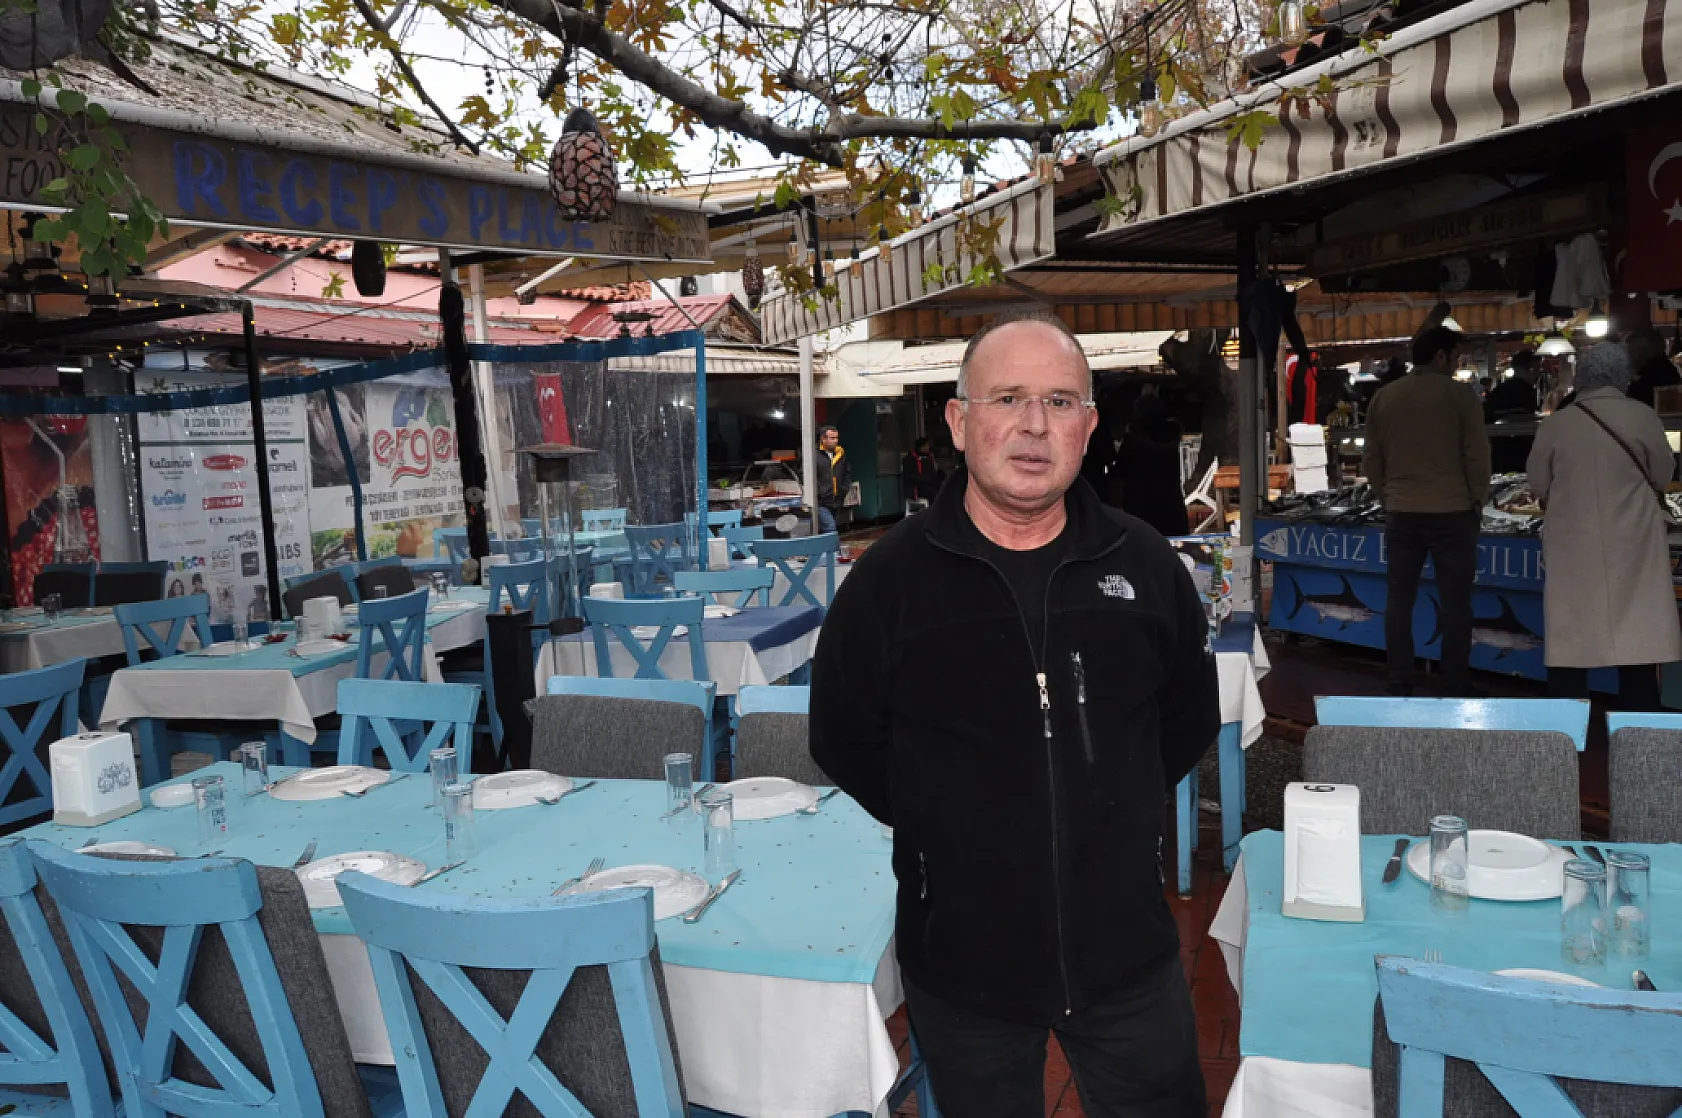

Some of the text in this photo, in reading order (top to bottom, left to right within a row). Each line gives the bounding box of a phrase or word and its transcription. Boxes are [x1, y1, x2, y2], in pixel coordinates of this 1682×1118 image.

[173, 140, 594, 250] RECEP'S PLACE
[1290, 525, 1367, 562] YAĞIZ
